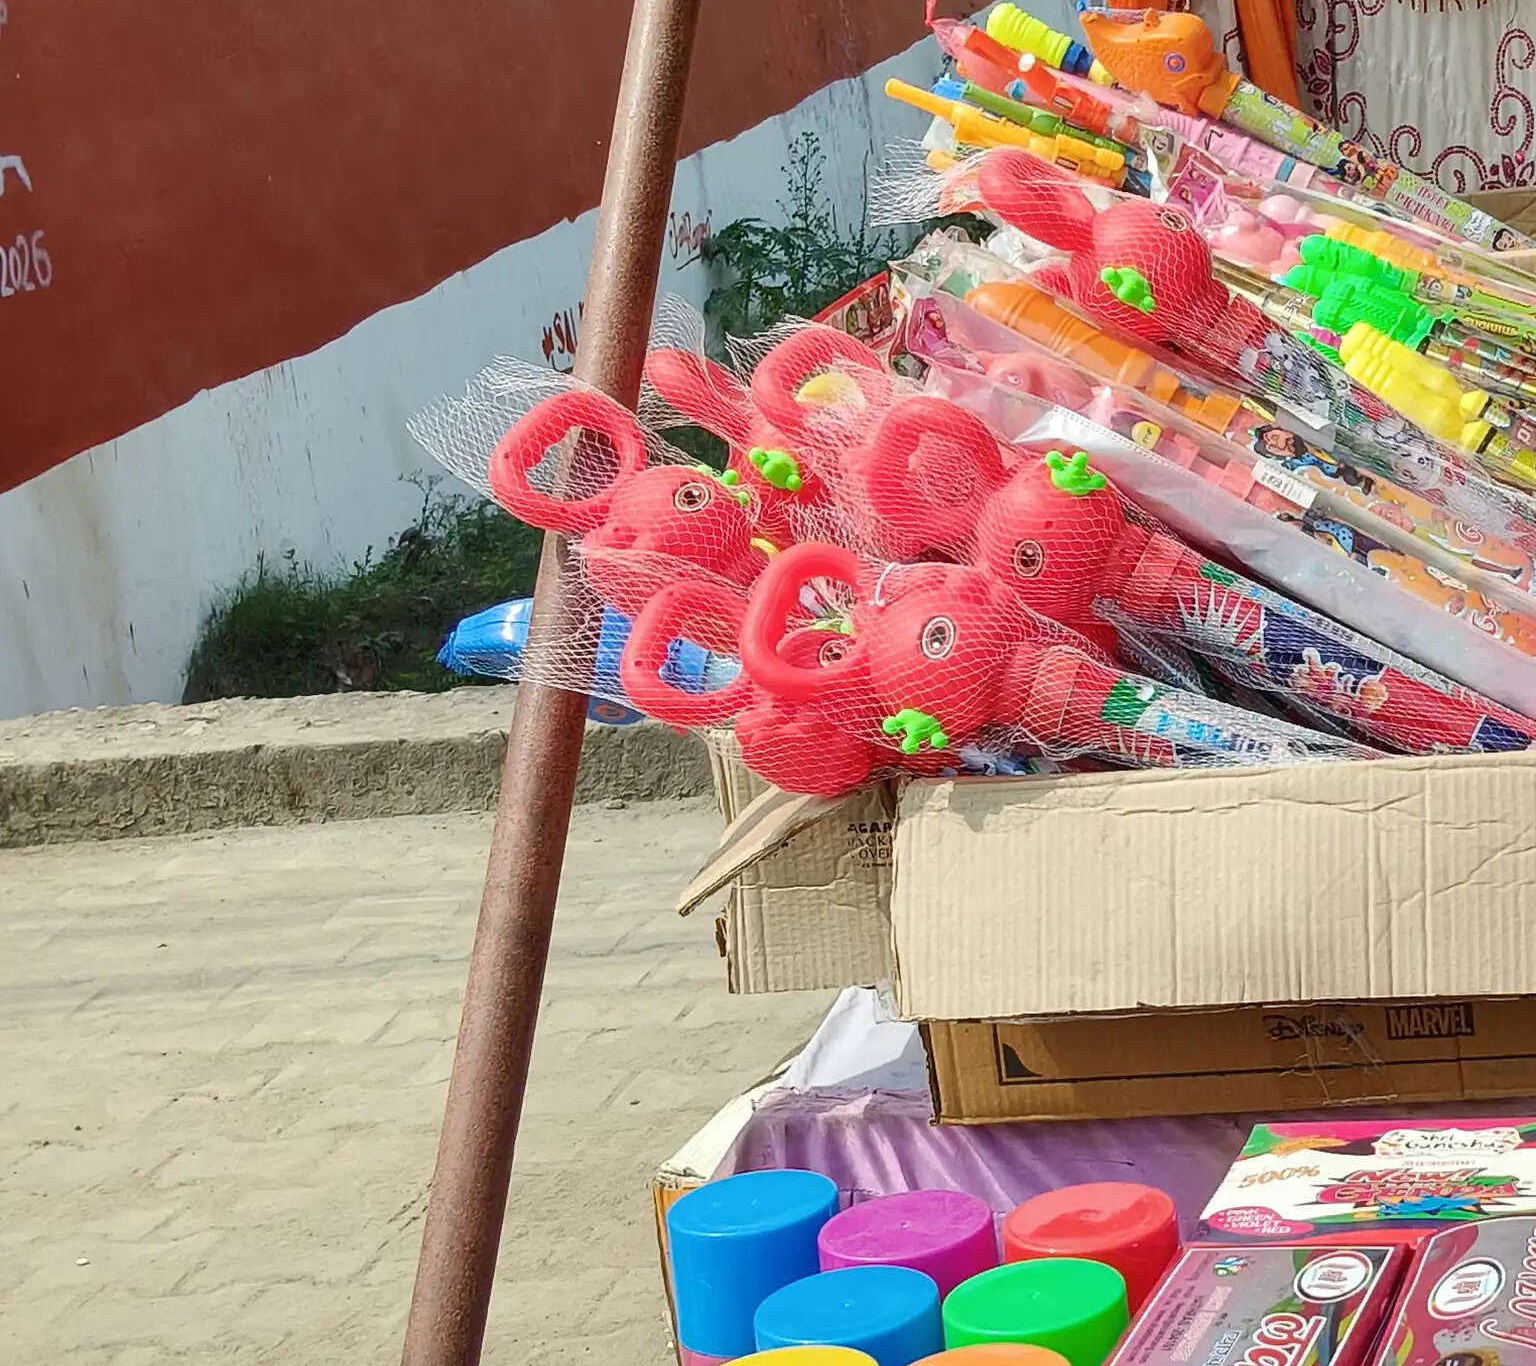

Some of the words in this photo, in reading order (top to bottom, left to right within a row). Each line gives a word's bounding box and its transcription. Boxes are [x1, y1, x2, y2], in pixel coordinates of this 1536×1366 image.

[1390, 1006, 1472, 1038] MARVEL
[1403, 1137, 1497, 1153] Ganesha
[1417, 1133, 1456, 1144] Shri
[1240, 1164, 1321, 1189] 500%
[1348, 1167, 1488, 1185] New!
[1210, 1330, 1242, 1359] प्यार
